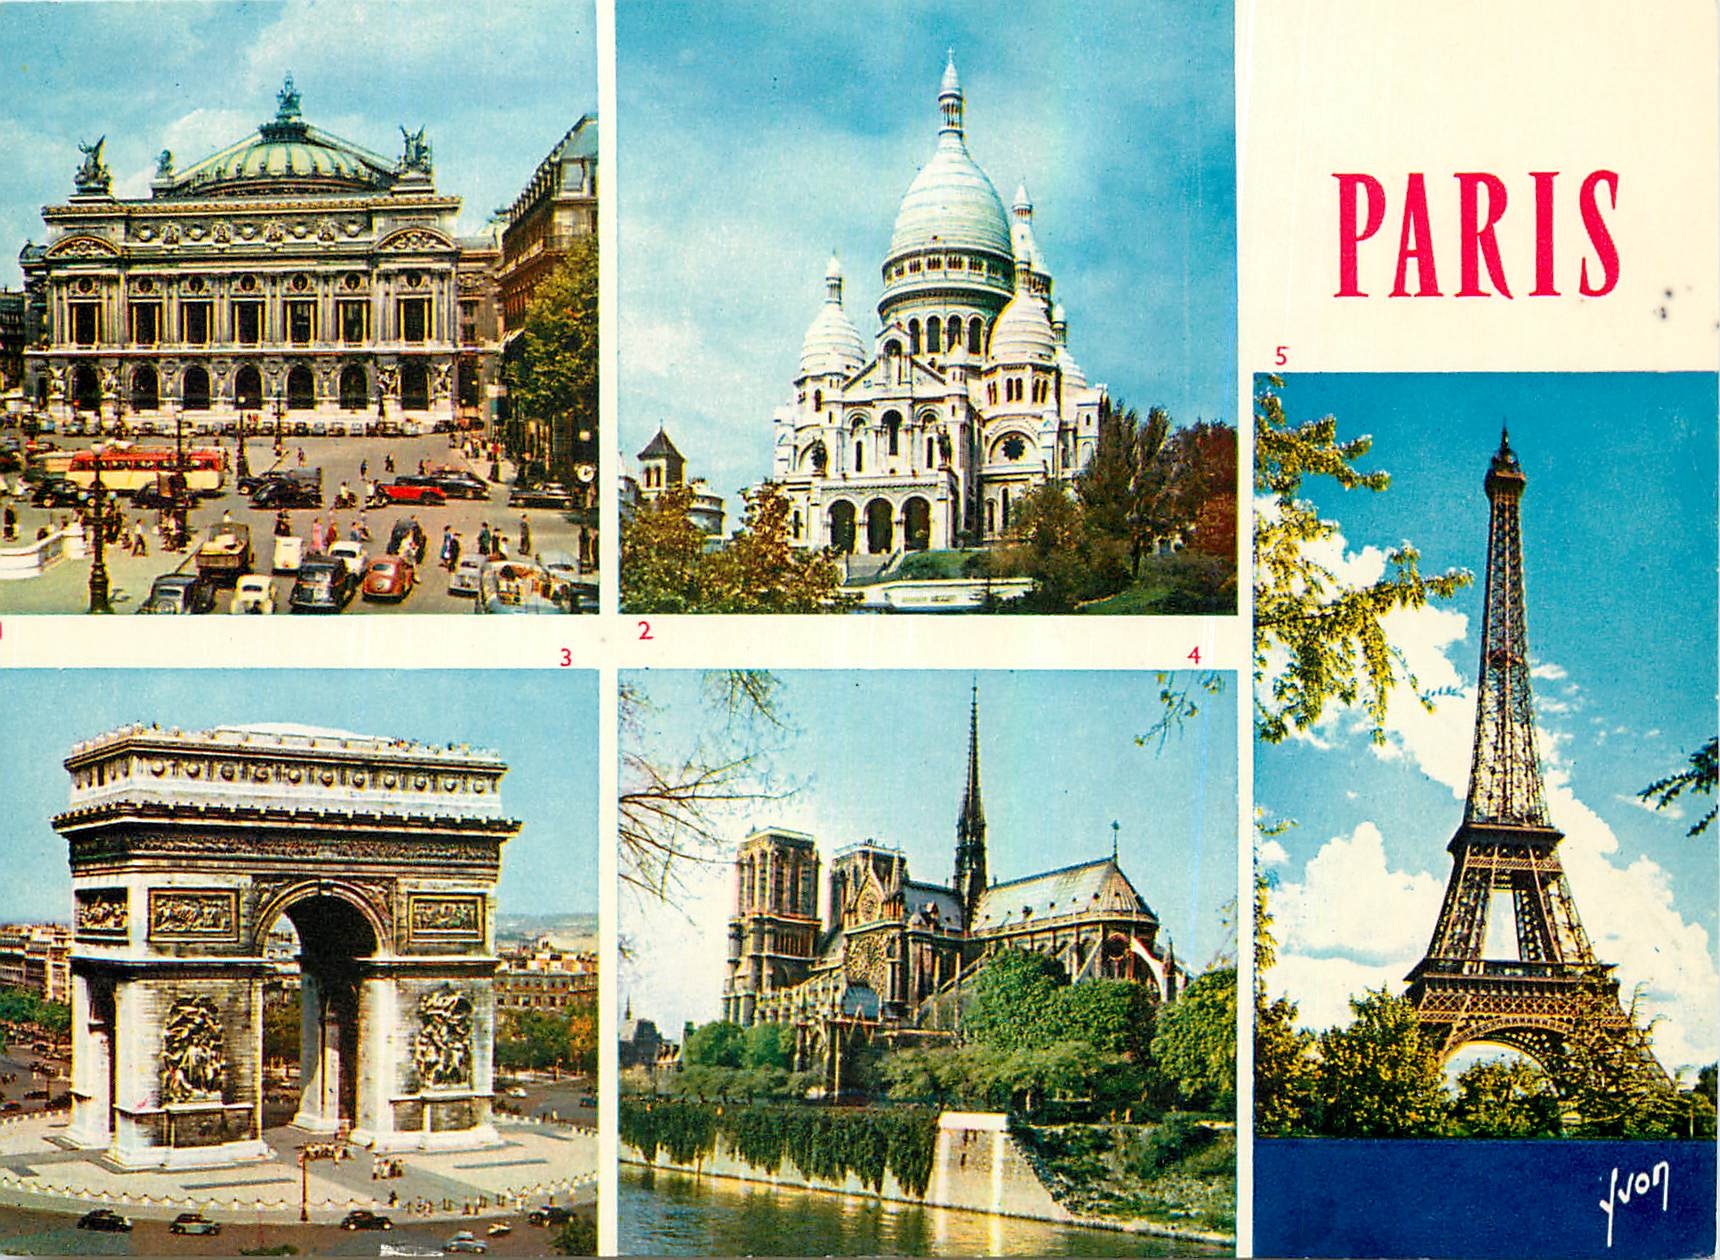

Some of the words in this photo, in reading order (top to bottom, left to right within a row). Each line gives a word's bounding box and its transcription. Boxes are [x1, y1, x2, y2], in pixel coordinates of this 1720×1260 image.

[1331, 169, 1621, 301] PARIS
[1275, 345, 1290, 366] 5
[638, 620, 654, 640] 2
[560, 647, 572, 667] 3
[1187, 645, 1202, 665] 4
